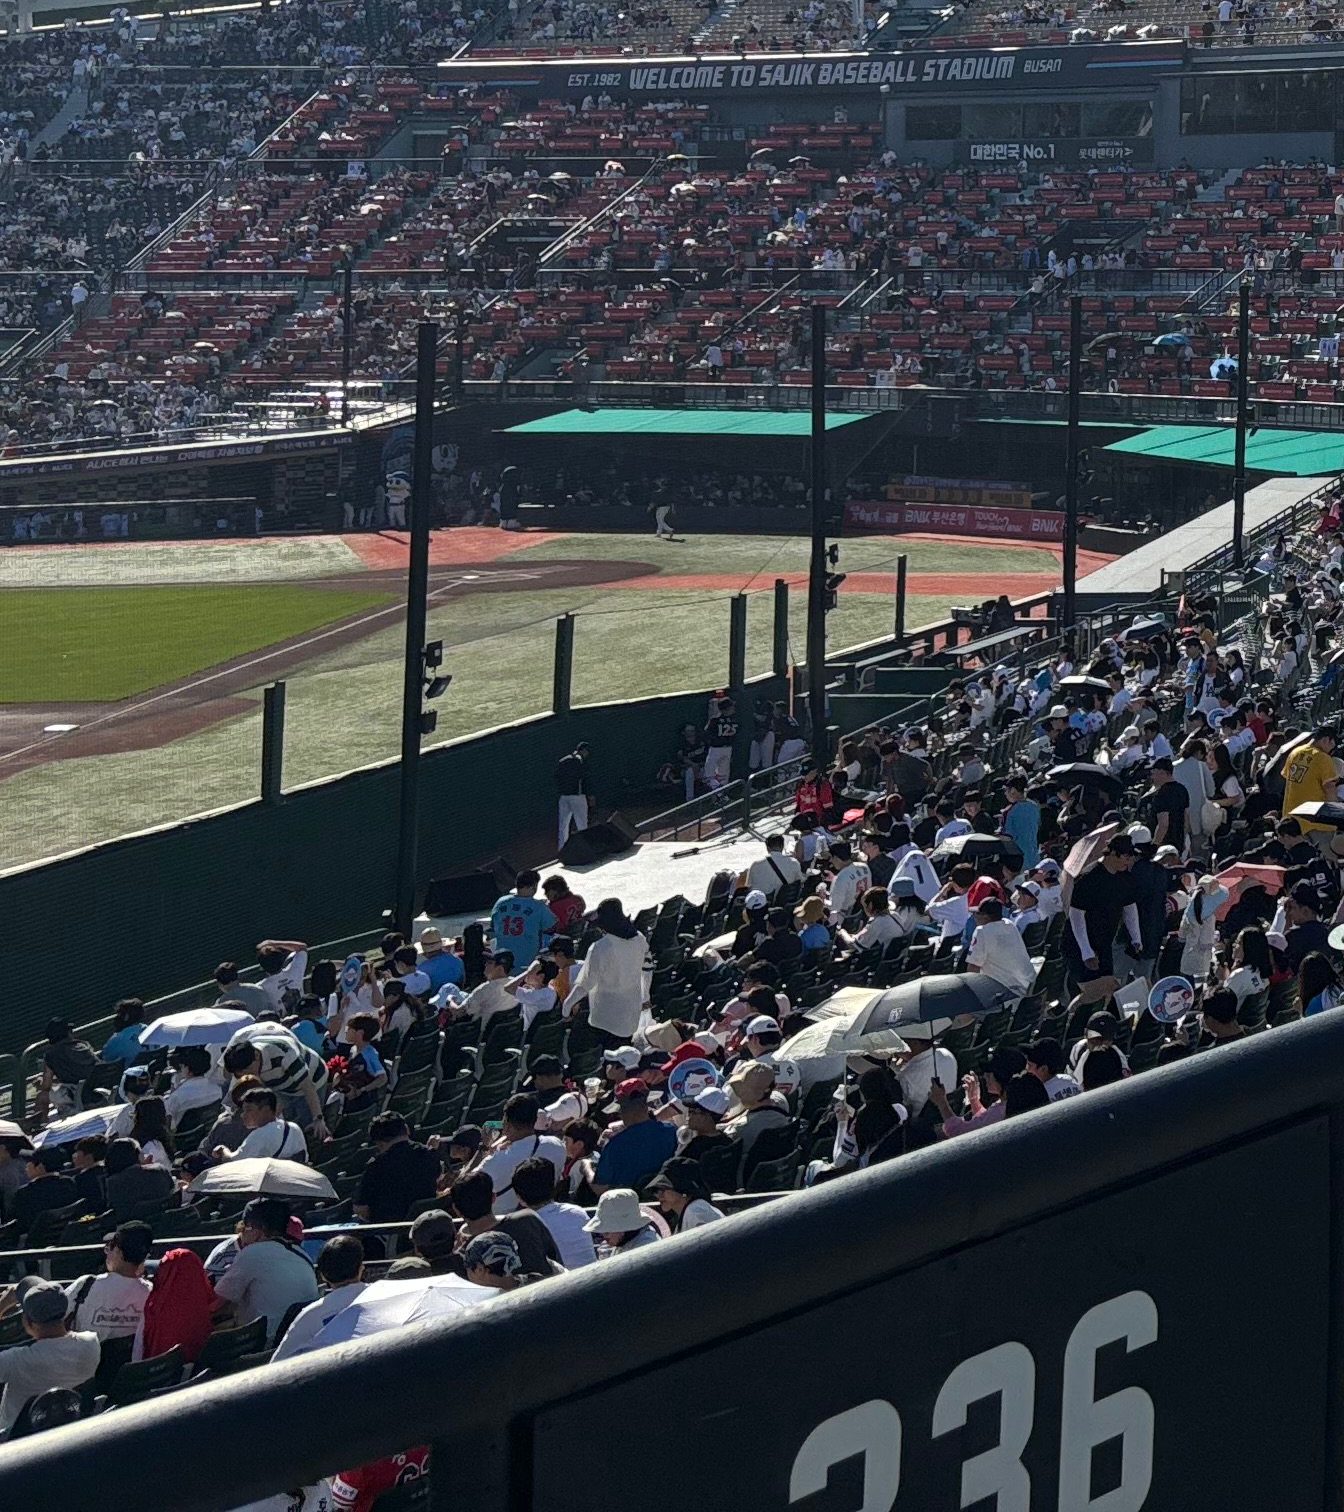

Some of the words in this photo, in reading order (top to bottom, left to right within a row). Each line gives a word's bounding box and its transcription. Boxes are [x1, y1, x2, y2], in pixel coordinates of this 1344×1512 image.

[567, 72, 622, 87] EST.1982
[629, 65, 727, 90] WELCOME
[729, 64, 756, 87] TO
[758, 63, 817, 87] SAJIK
[817, 59, 918, 85] BASEBALL
[922, 55, 1016, 82] STADIUM
[1023, 58, 1063, 73] BUSAN
[970, 143, 1021, 161] 대한민국
[1023, 143, 1055, 159] No.1
[905, 510, 931, 524] BNK
[932, 510, 966, 527] 부산은행
[1031, 518, 1060, 533] BNK
[717, 723, 738, 737] 125
[502, 915, 524, 937] 13
